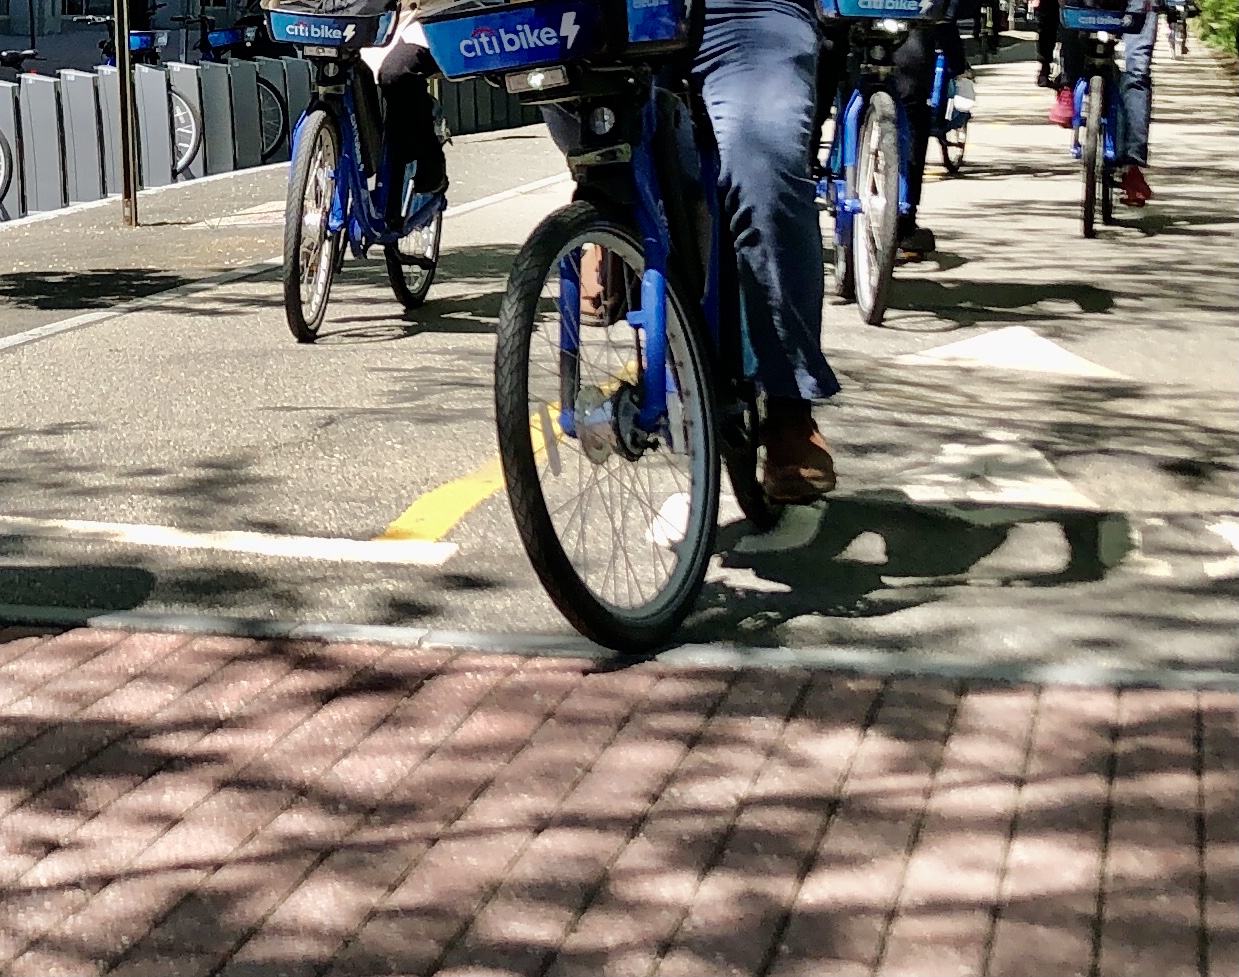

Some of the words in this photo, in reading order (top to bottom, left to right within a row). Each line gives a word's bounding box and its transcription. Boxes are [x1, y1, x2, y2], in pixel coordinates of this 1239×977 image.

[285, 24, 309, 37] citi
[310, 24, 342, 39] bike
[460, 29, 500, 58] citi
[500, 24, 560, 52] bike
